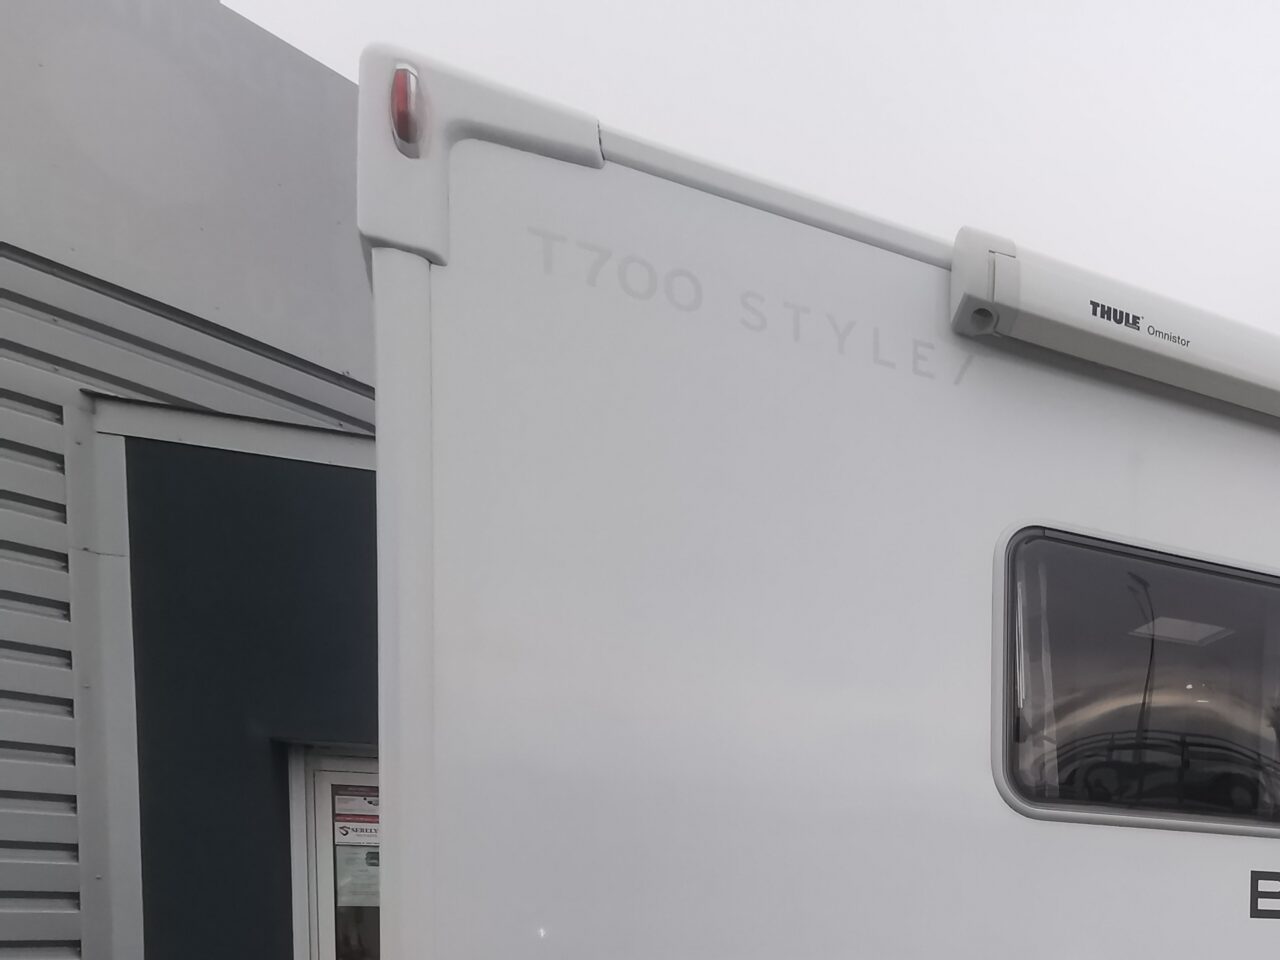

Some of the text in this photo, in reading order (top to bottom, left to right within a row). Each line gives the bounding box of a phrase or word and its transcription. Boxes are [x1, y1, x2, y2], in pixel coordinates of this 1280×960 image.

[526, 225, 704, 312] T700
[1089, 299, 1190, 347] THULE Omnistor
